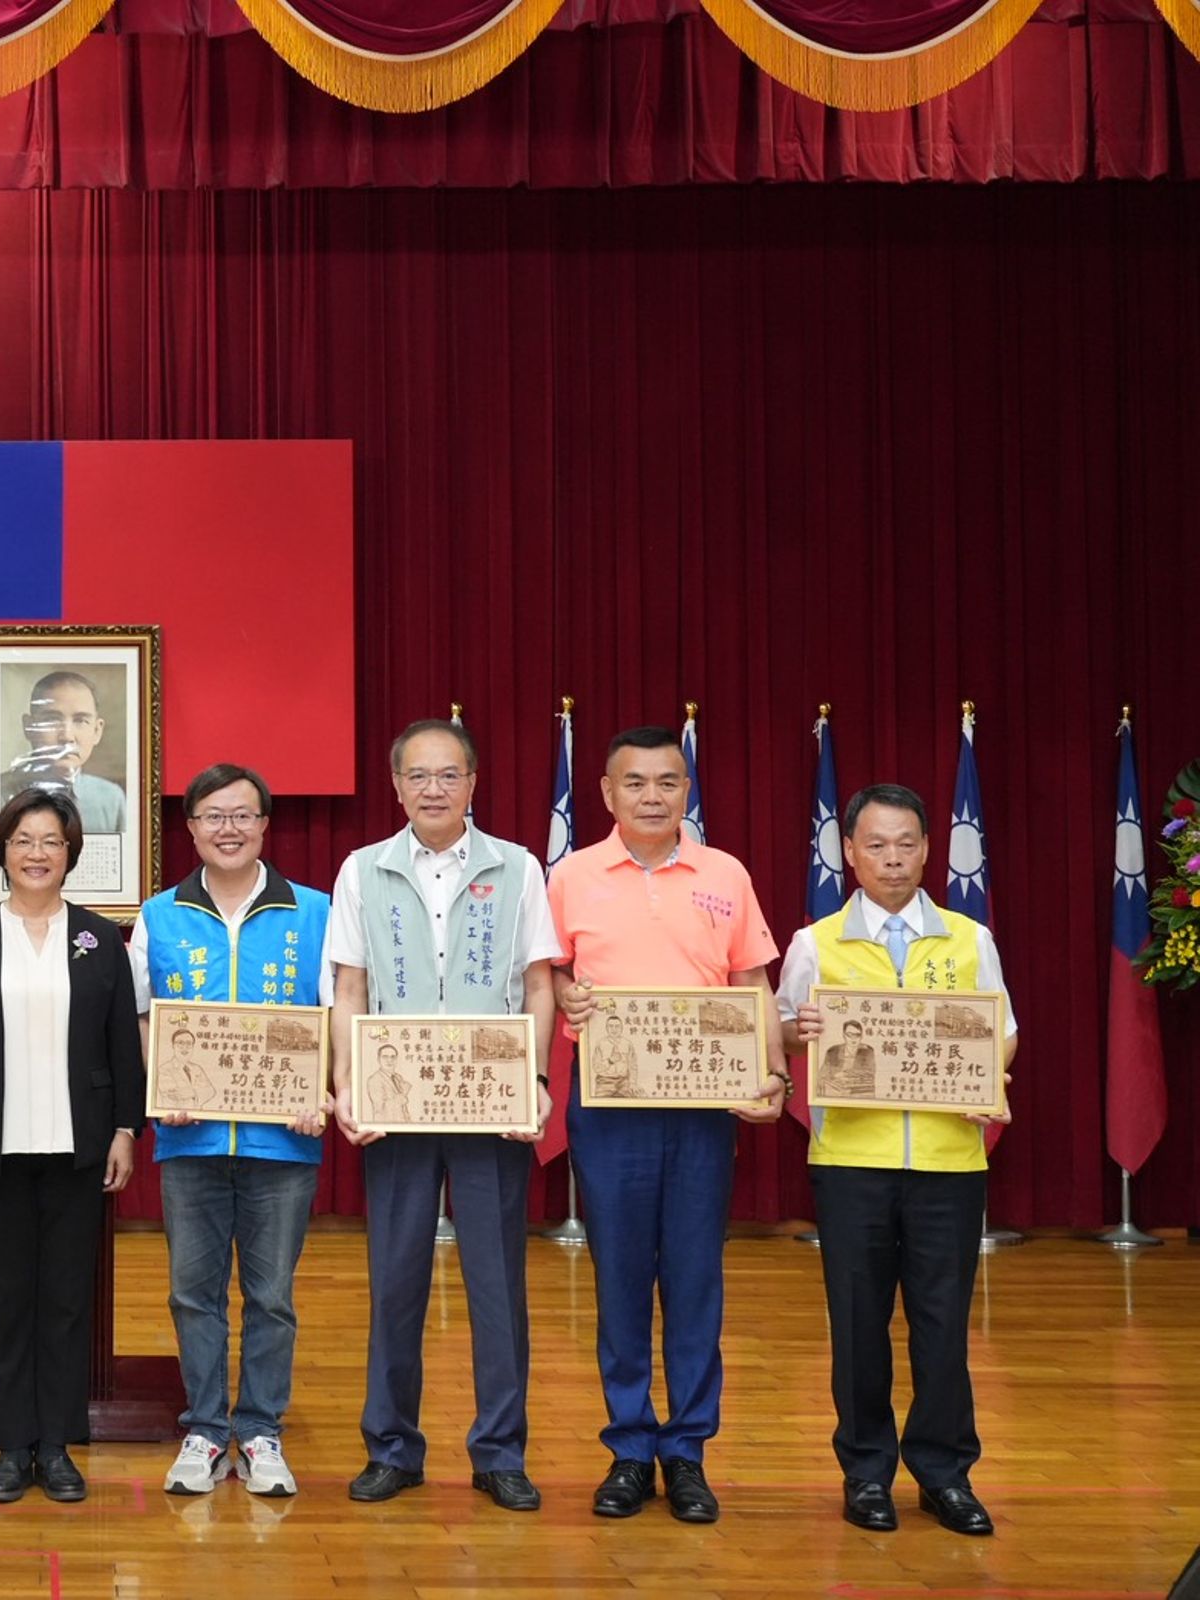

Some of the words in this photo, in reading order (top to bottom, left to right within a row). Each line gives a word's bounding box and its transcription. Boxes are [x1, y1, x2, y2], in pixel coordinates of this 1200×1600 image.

[389, 905, 403, 947] 大隊長
[463, 903, 478, 985] 志工大隊
[481, 903, 494, 987] 彰化縣警察局
[282, 930, 299, 1006] 彰化縣保
[924, 959, 938, 989] 大隊
[945, 958, 957, 990] 彰化
[166, 972, 183, 1000] 楊
[666, 1057, 747, 1074] 功在彰化
[900, 1060, 986, 1078] 功在彰化
[231, 1073, 310, 1090] 功在彰化
[434, 1083, 516, 1099] 功在彰化
